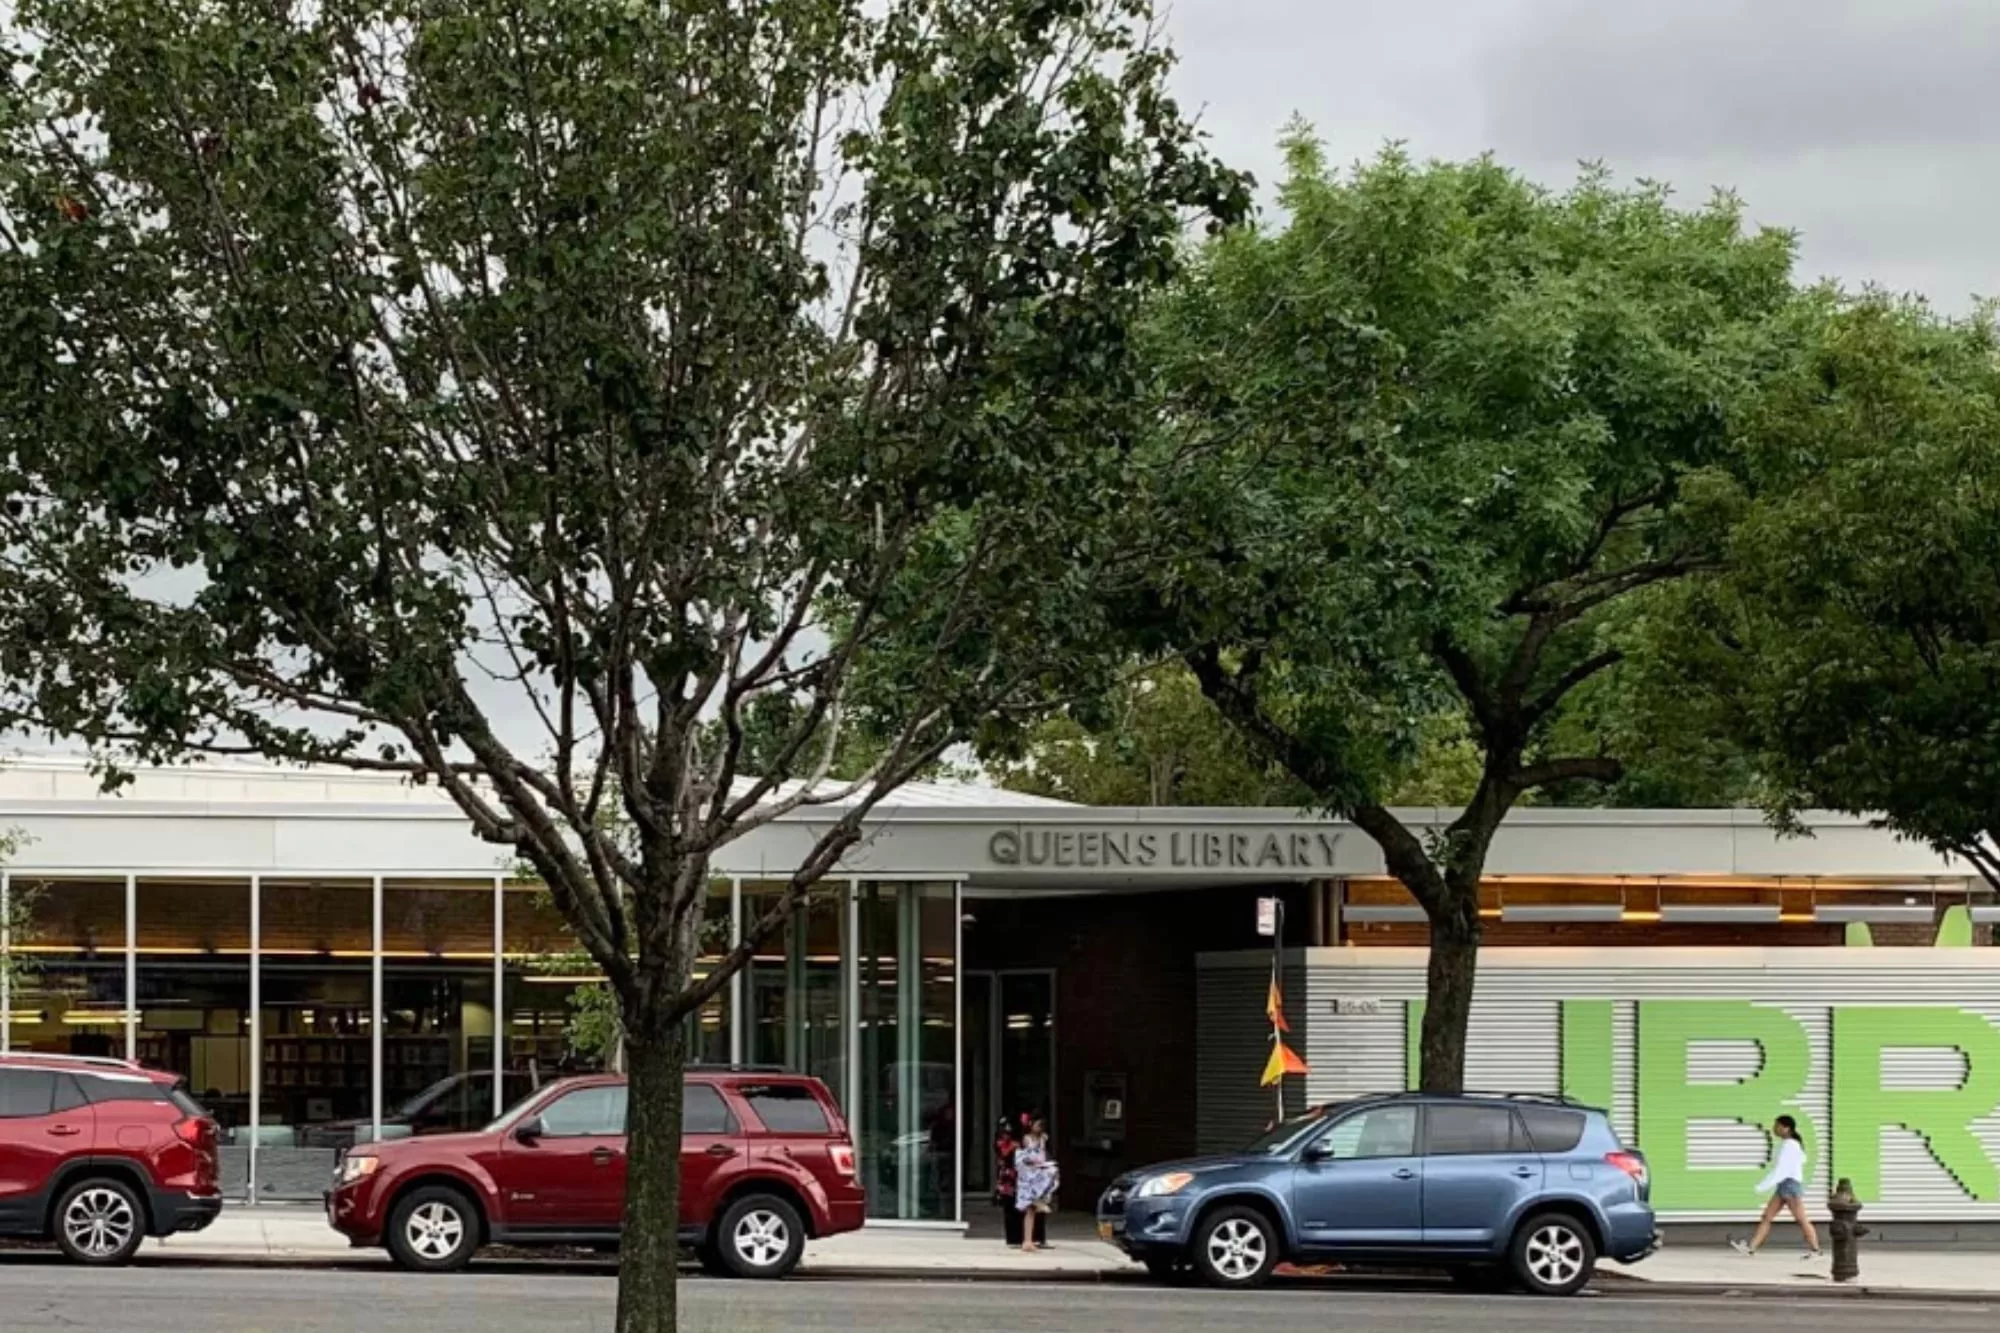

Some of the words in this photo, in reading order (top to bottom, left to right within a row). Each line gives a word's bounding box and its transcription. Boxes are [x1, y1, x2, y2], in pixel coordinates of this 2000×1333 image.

[988, 830, 1157, 866] QUEENS
[1169, 832, 1343, 868] LIBRARY
[1405, 999, 2000, 1210] IBR
